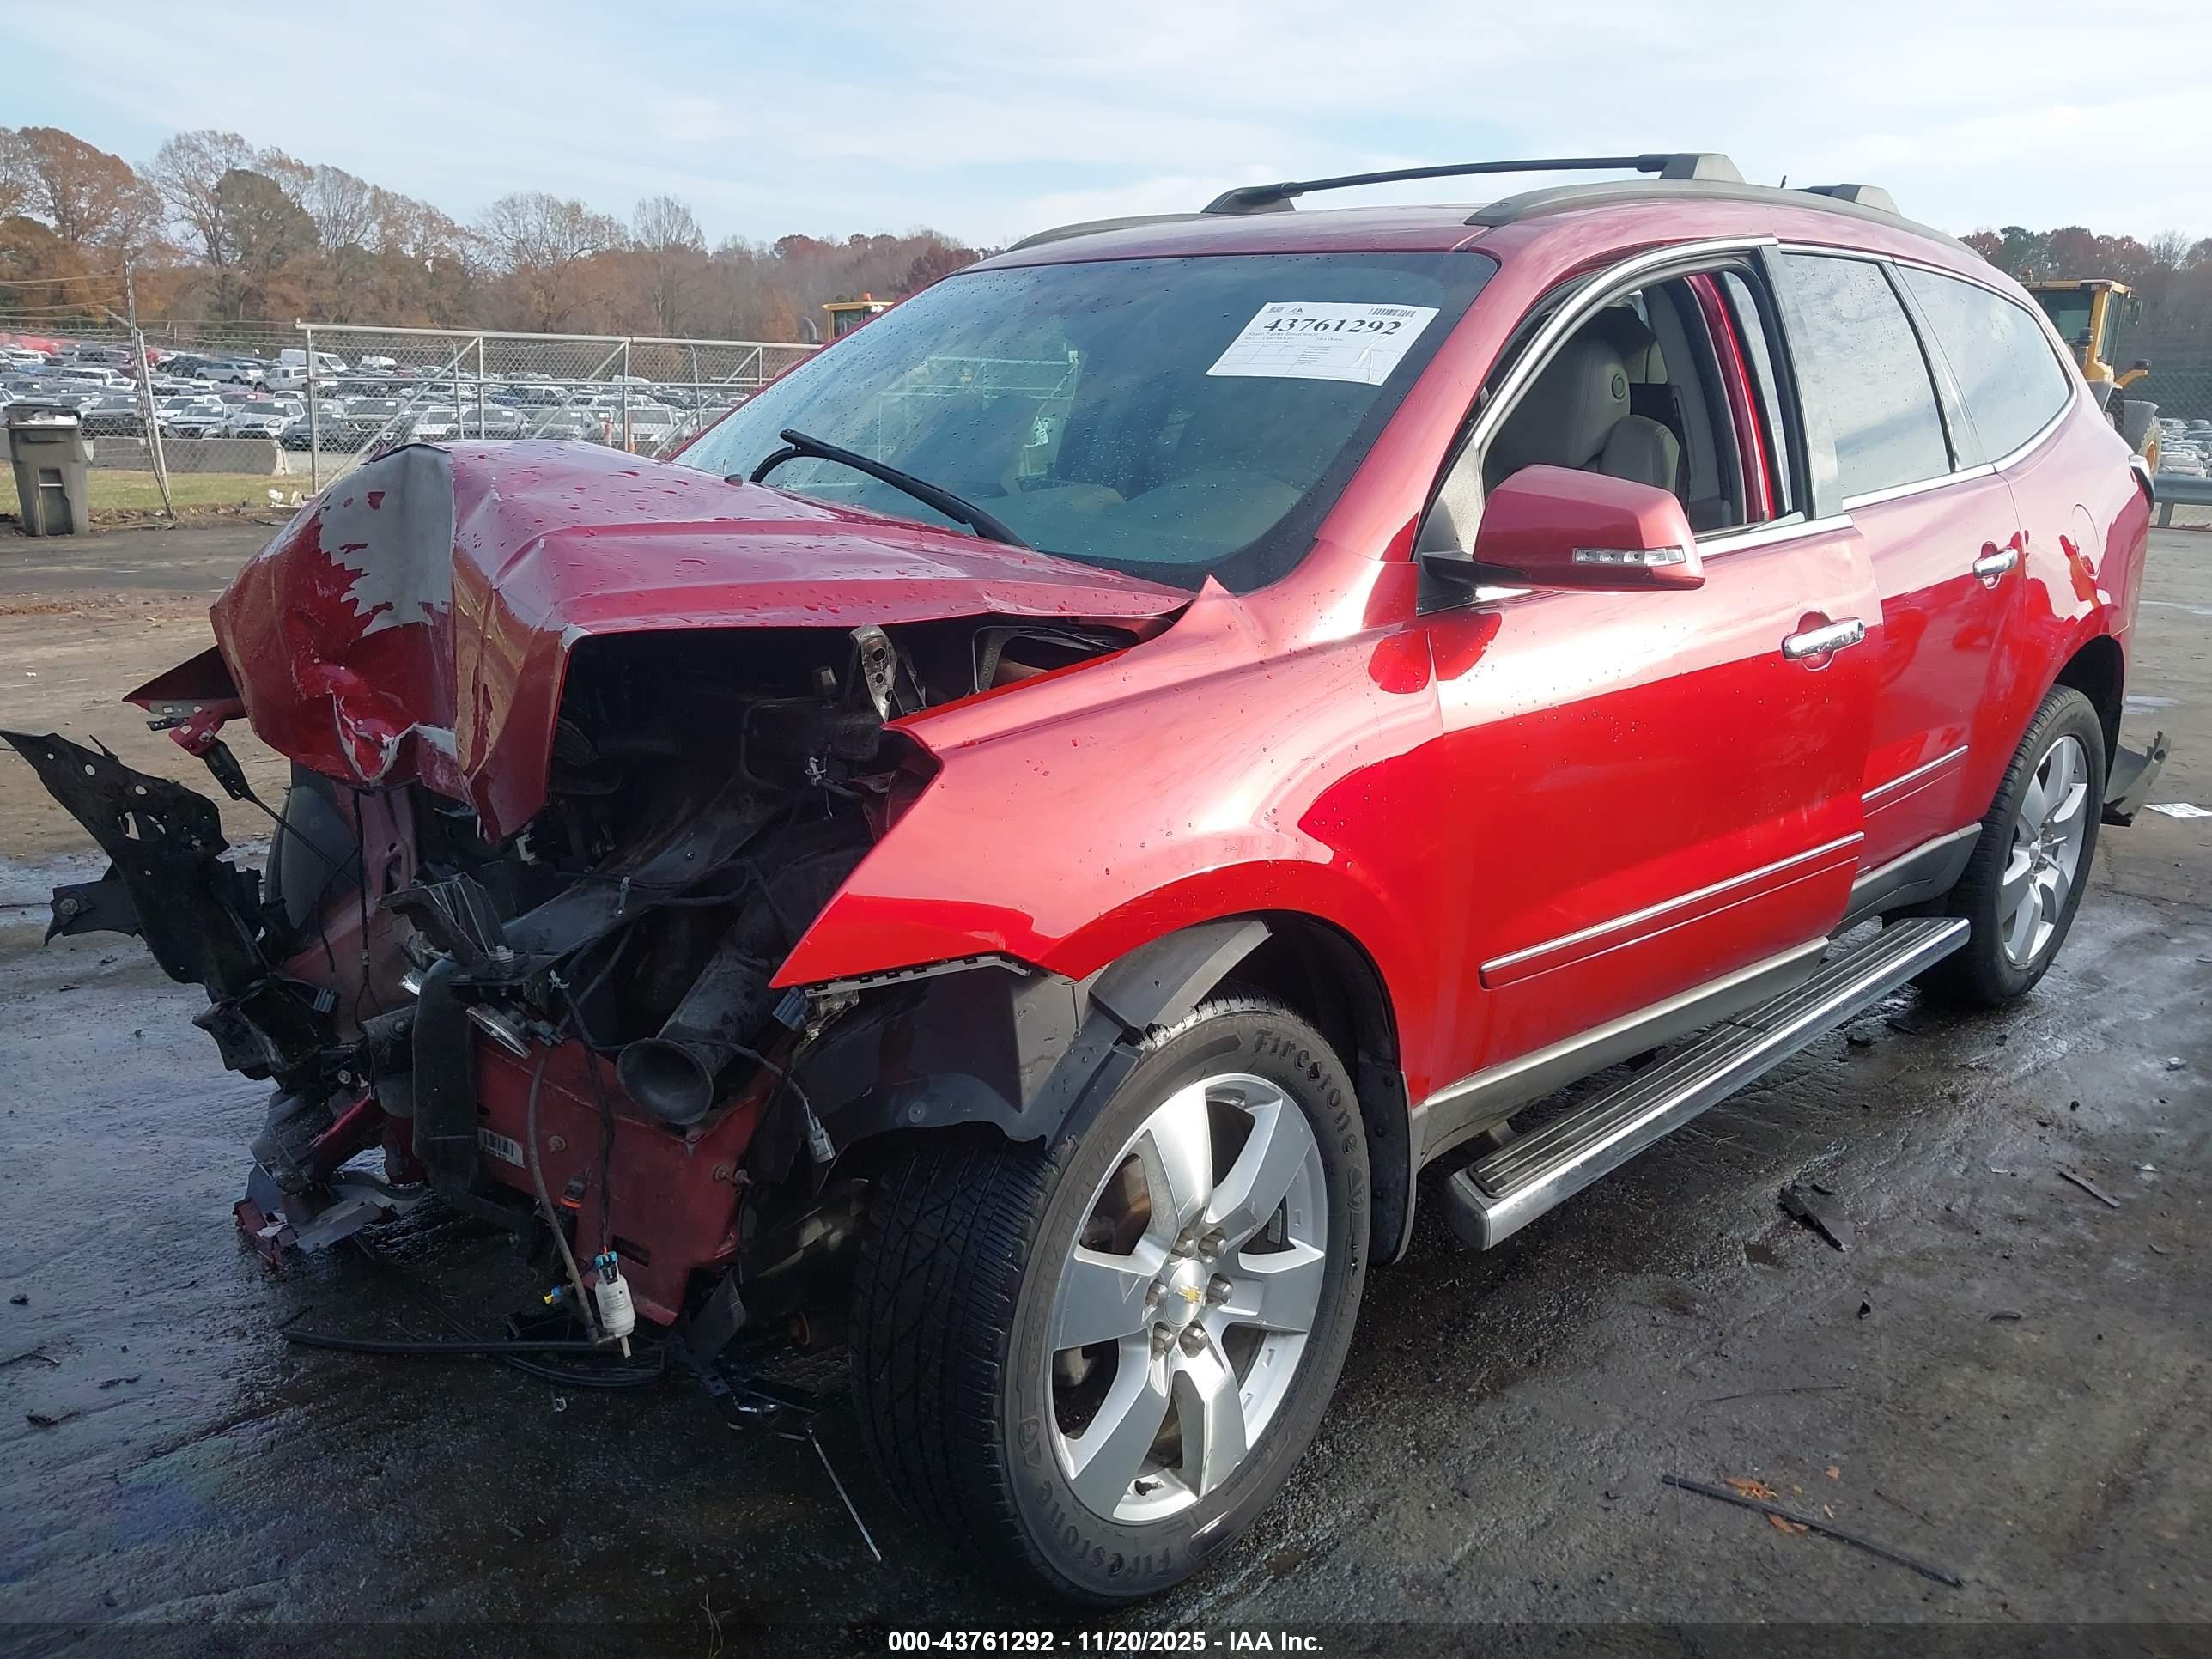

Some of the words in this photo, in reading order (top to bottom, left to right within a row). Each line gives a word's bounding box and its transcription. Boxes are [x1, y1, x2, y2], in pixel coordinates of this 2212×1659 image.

[1263, 319, 1401, 336] 43761292
[1253, 1028, 1358, 1156] Firestone
[1036, 1480, 1174, 1577] Firestone
